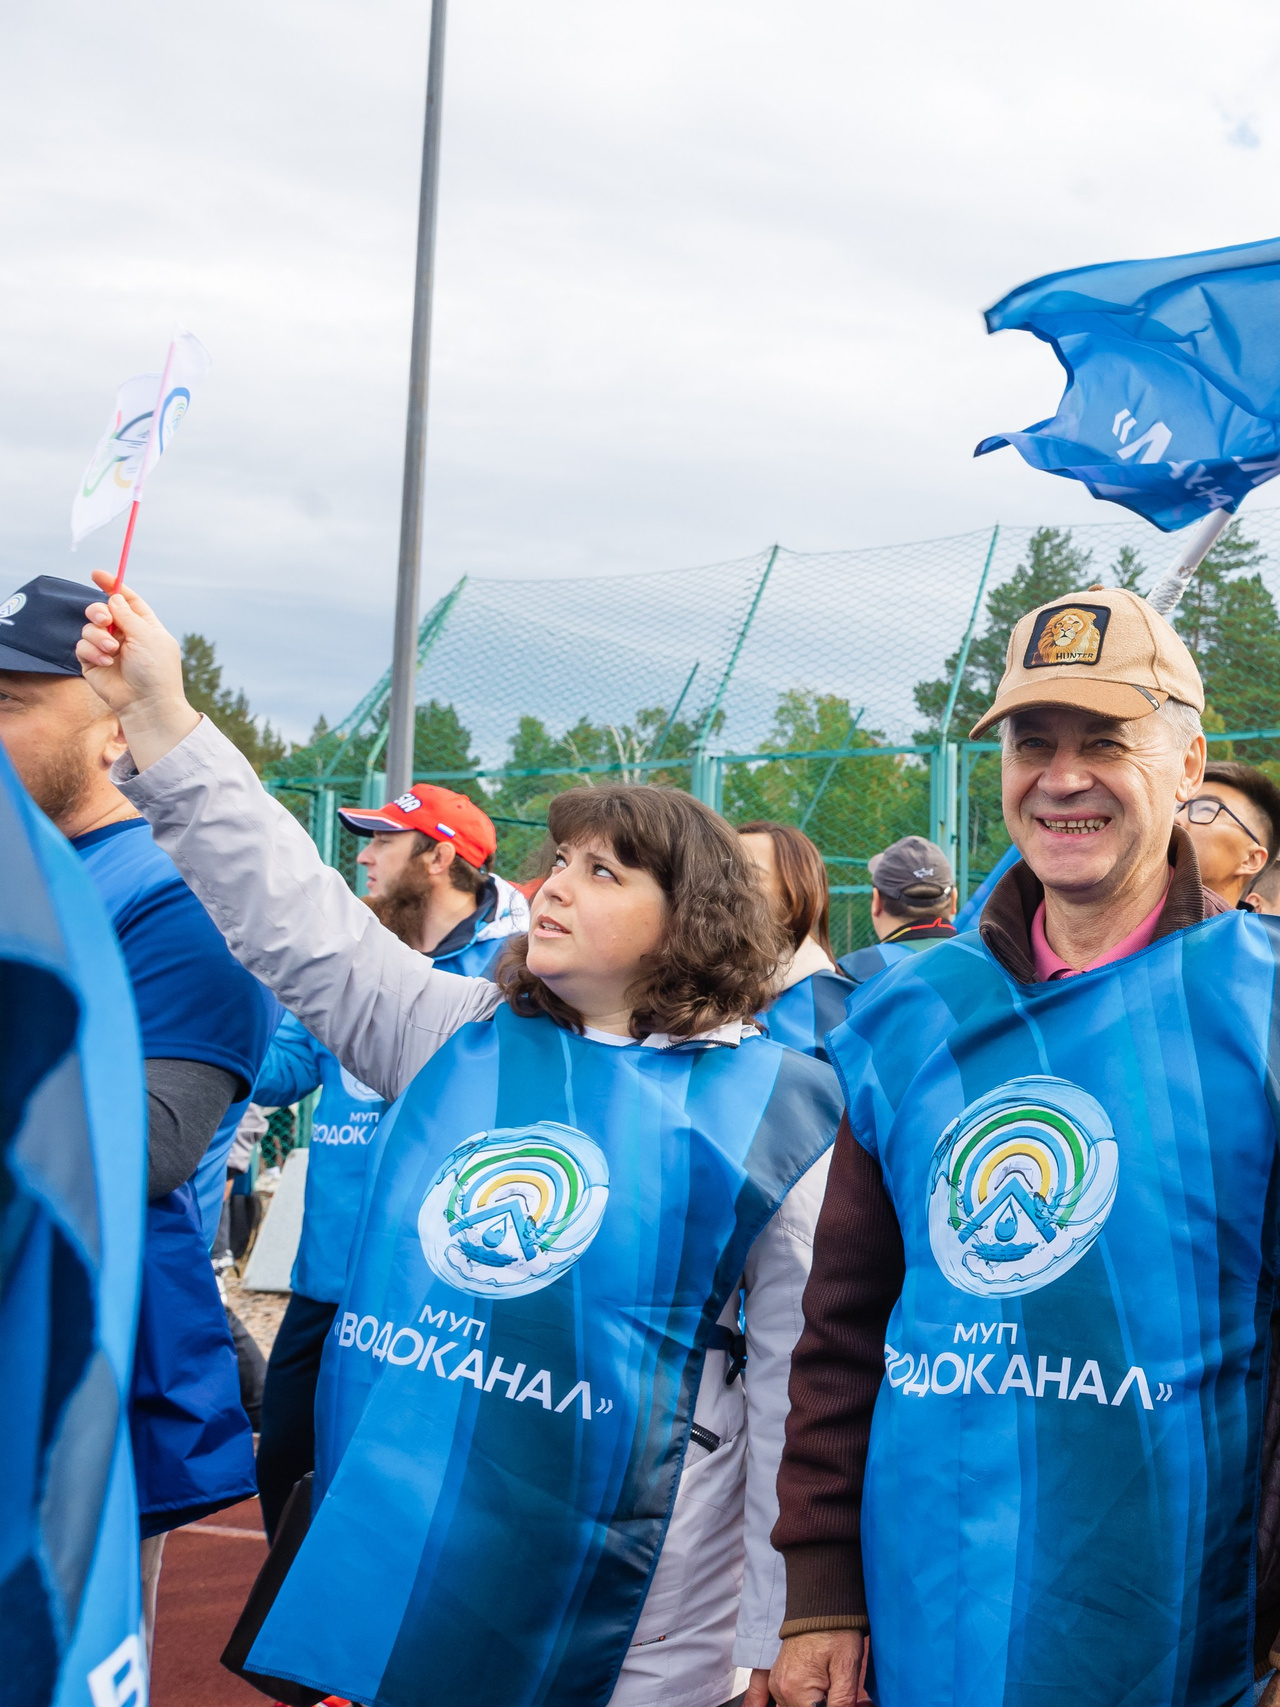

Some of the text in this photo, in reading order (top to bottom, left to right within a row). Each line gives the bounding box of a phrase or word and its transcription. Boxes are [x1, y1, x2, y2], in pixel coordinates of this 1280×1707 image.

[1056, 652, 1094, 661] HUNTER
[349, 1112, 380, 1123] МУП
[313, 1124, 378, 1146] ОДОК
[418, 1304, 486, 1341] МУП
[953, 1322, 1019, 1345] МУП
[334, 1311, 614, 1421] «ВОДОКАНАЛ»
